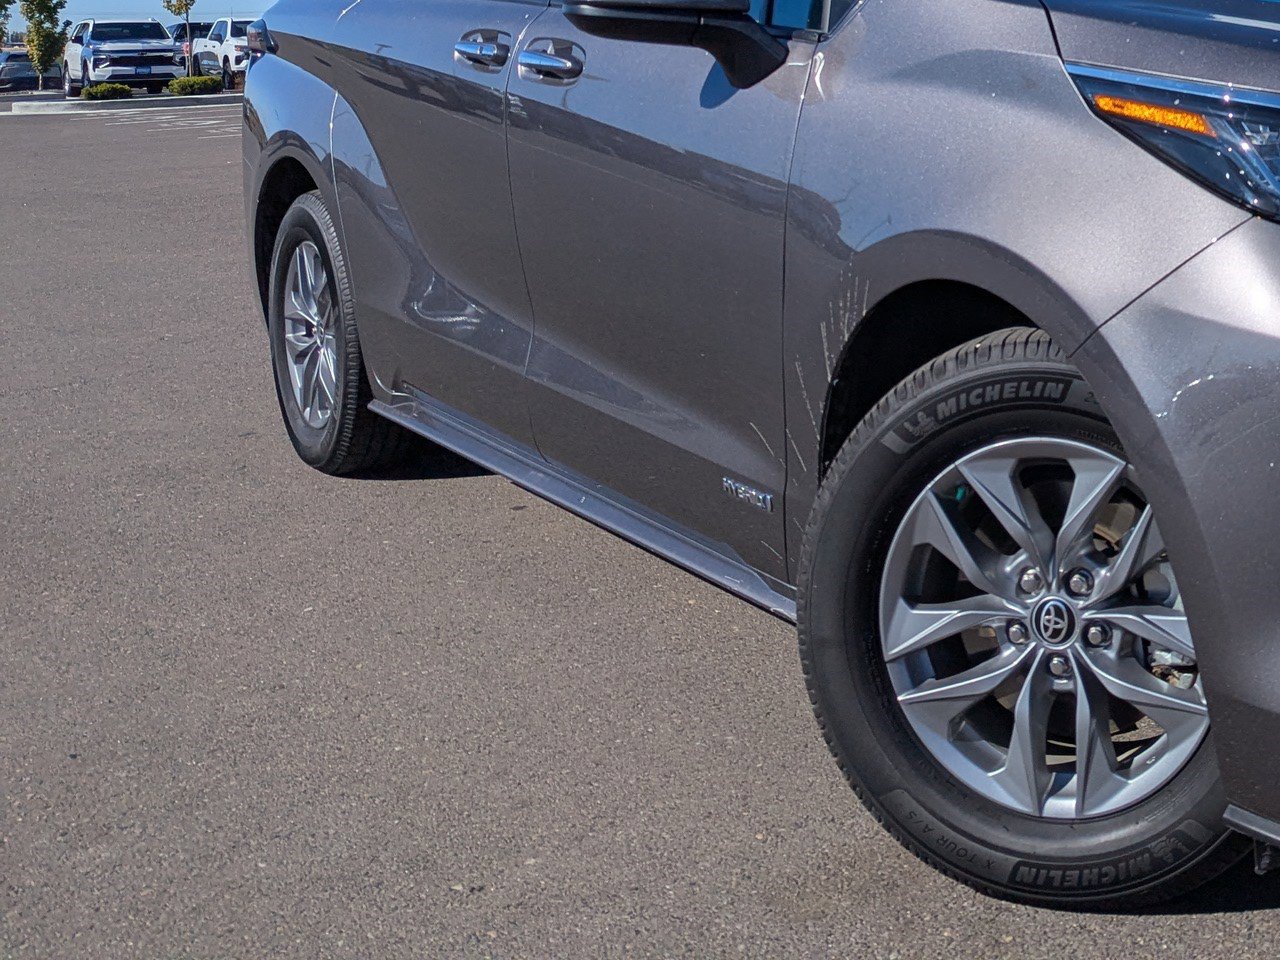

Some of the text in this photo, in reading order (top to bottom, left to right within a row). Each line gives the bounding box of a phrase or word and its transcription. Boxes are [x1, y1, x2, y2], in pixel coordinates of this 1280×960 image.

[936, 380, 1066, 419] MICHELIN
[937, 834, 977, 864] TOUR
[1016, 850, 1151, 888] MICHELIN
